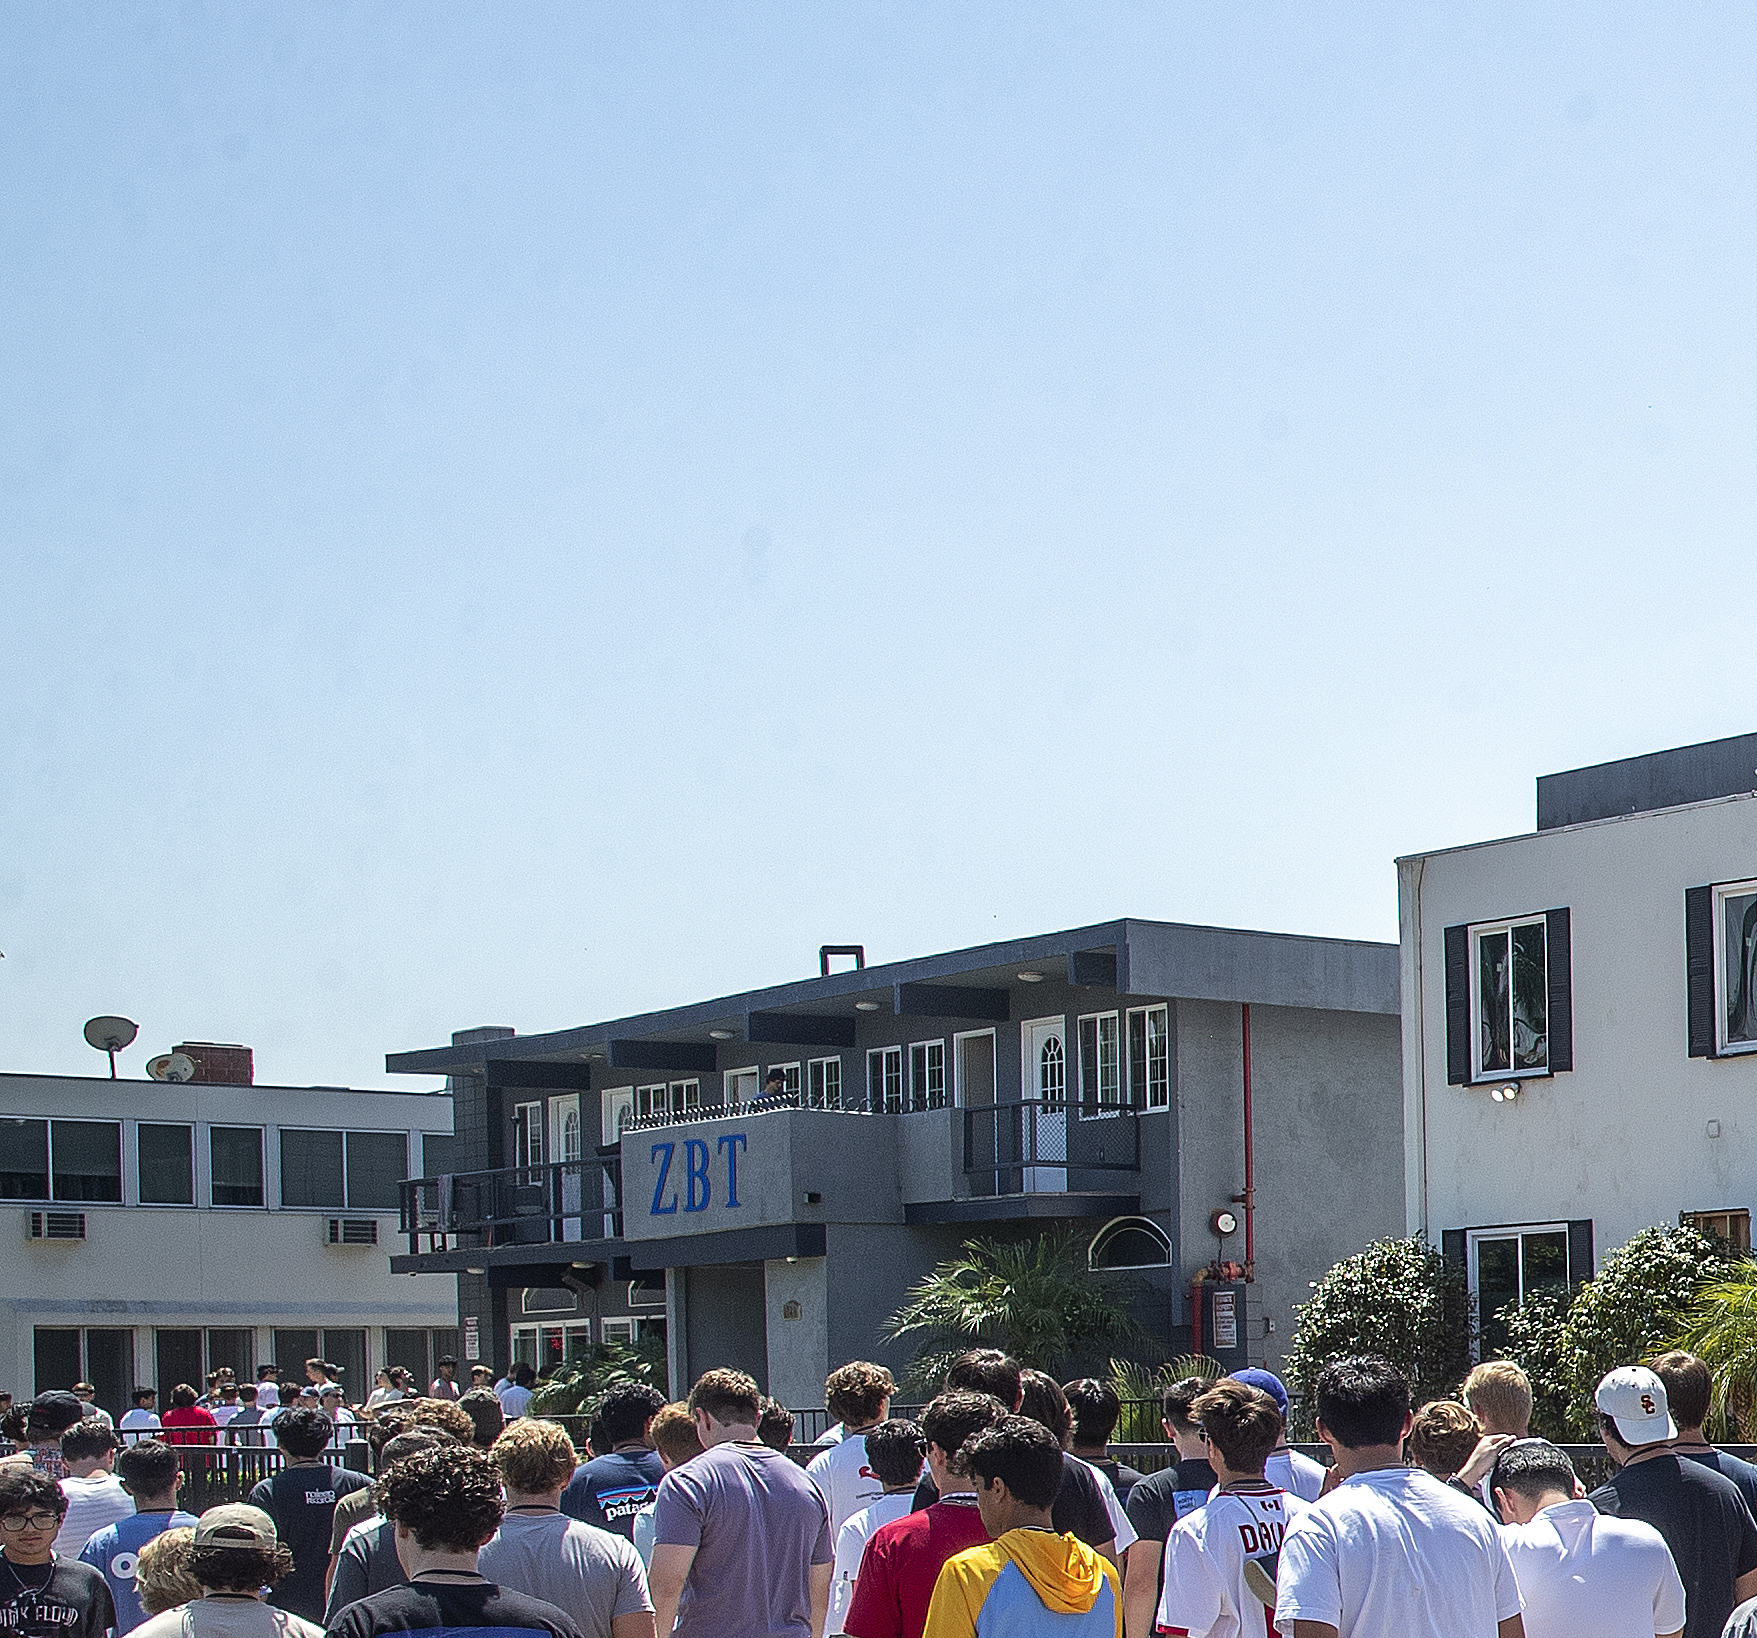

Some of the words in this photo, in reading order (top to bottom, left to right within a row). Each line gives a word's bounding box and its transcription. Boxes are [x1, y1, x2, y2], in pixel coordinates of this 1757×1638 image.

[649, 1132, 747, 1215] ZBT
[0, 1606, 29, 1628] INK
[35, 1605, 79, 1628] FLOYD
